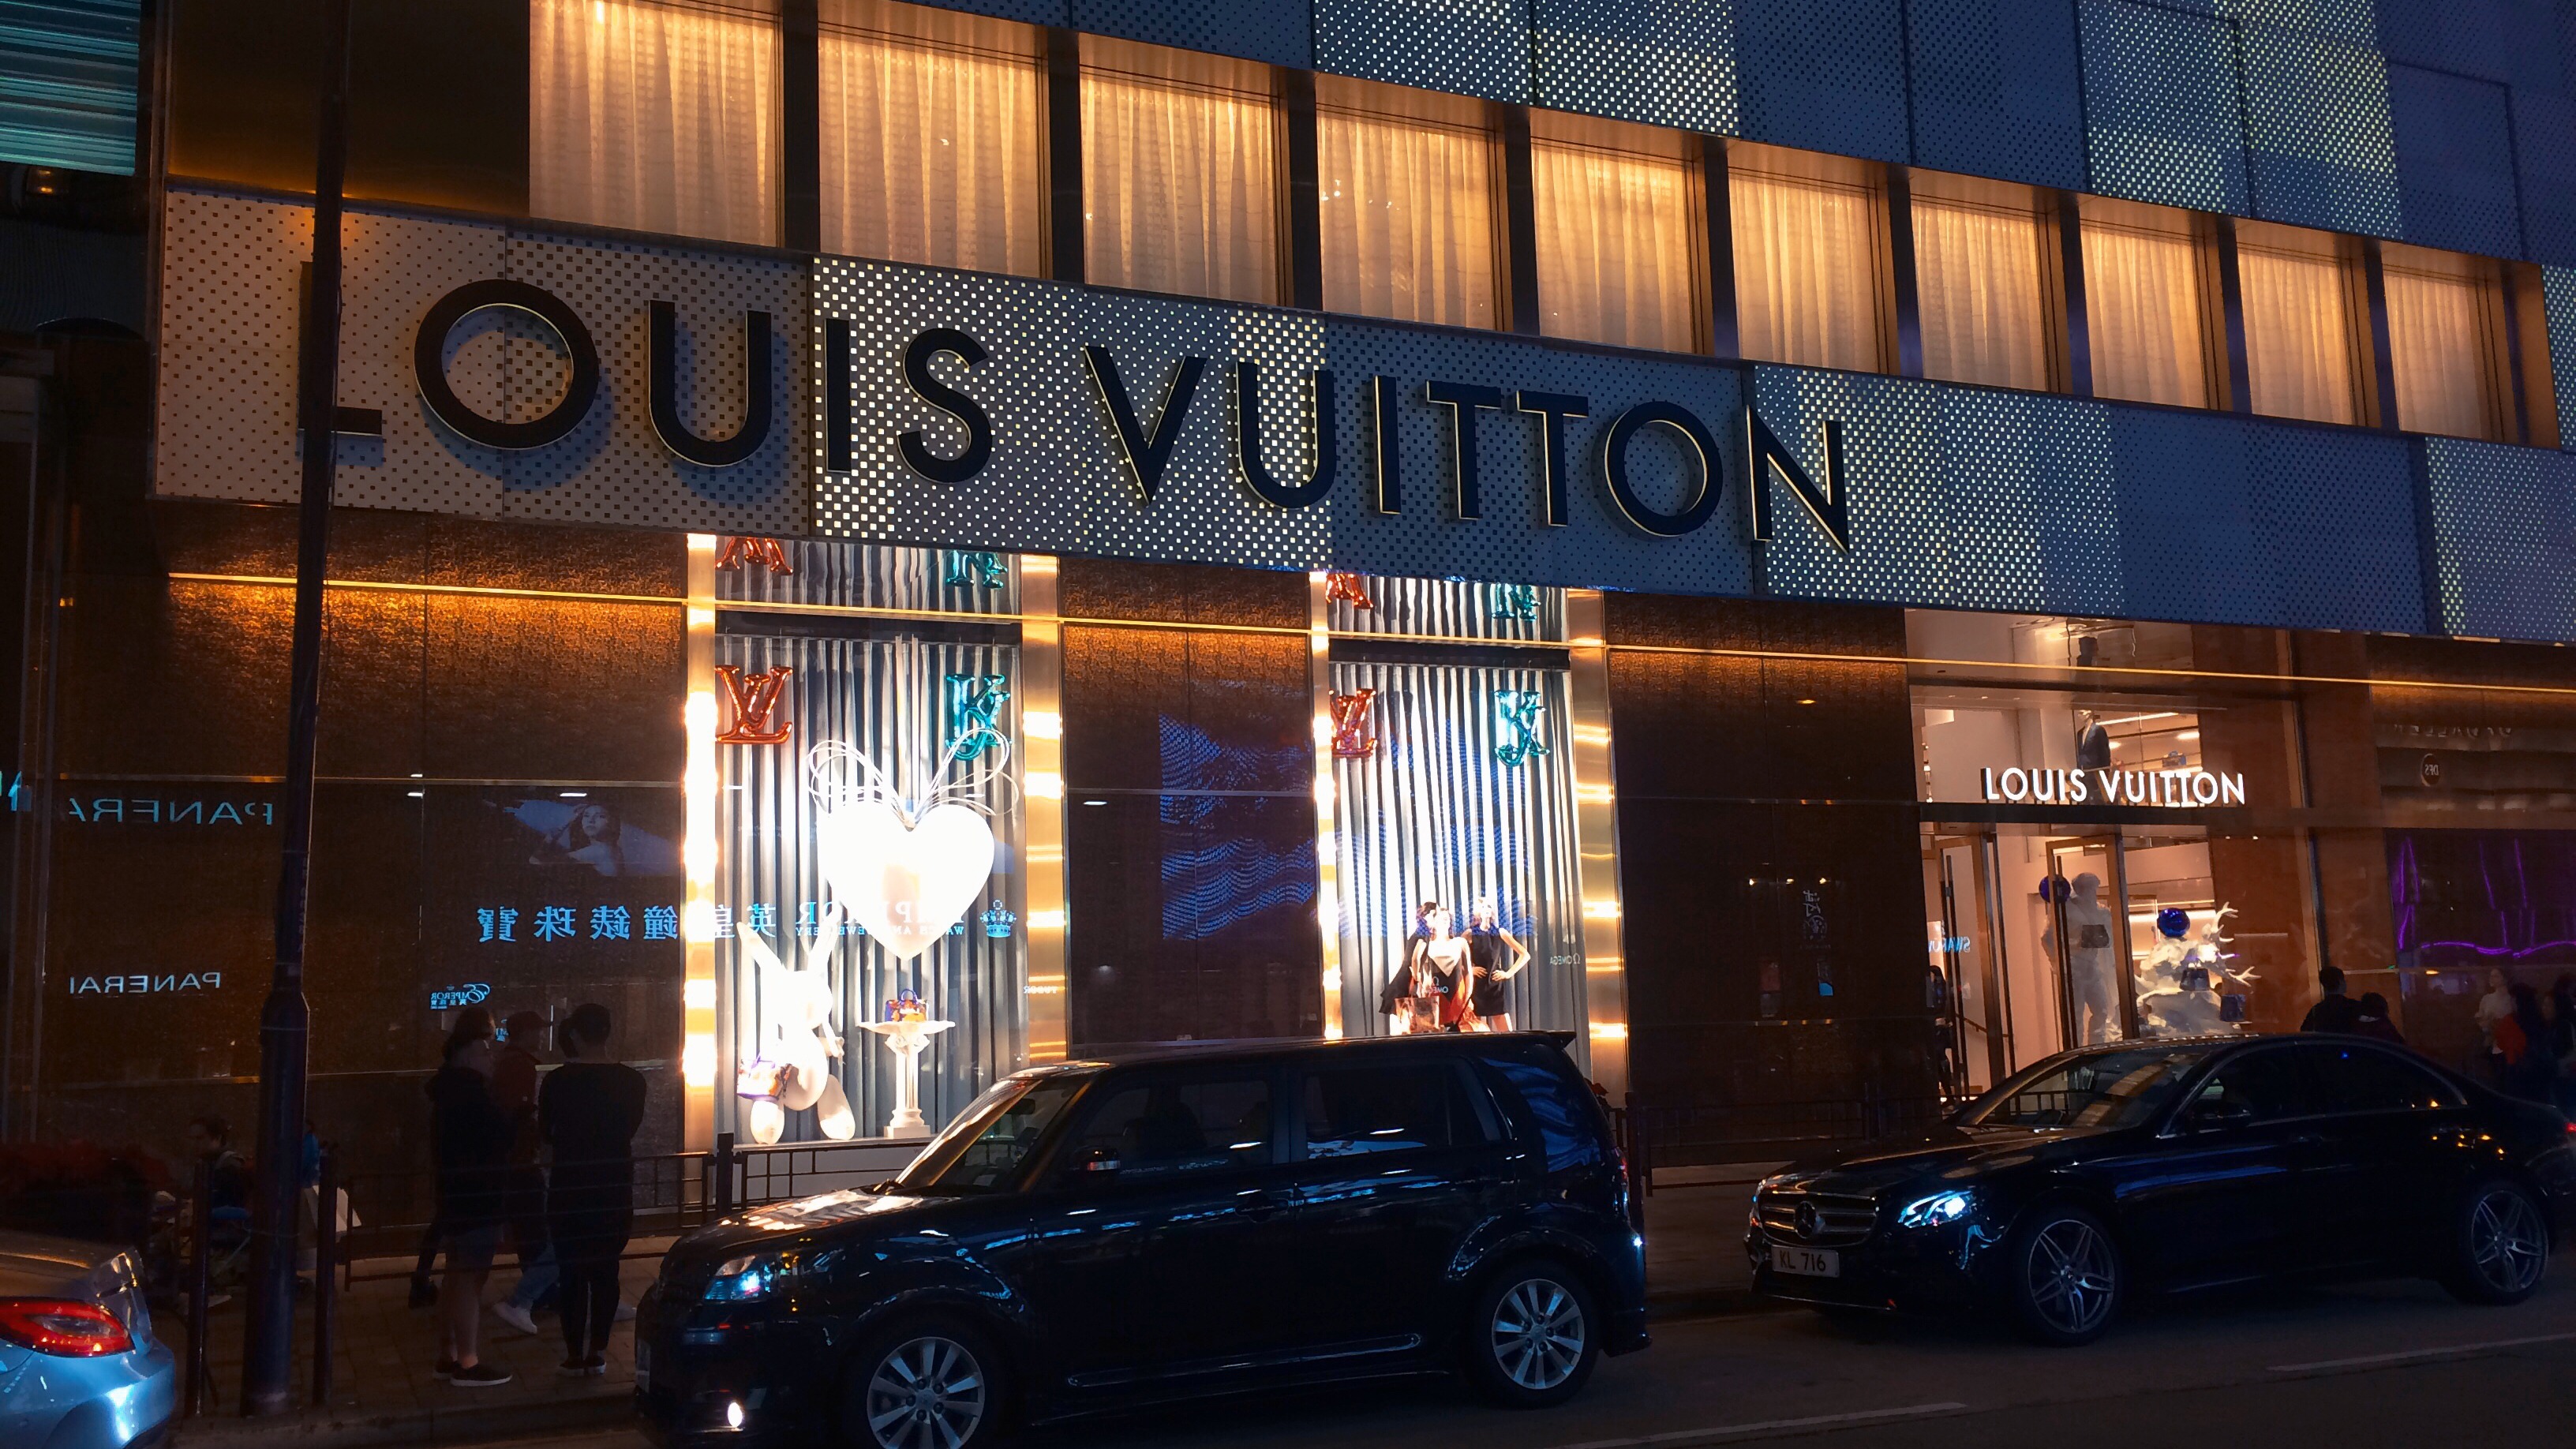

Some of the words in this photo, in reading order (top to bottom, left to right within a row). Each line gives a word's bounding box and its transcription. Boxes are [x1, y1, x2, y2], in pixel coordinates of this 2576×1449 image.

[1084, 345, 1849, 554] VUITTON
[1981, 767, 2088, 802] LOUIS
[2099, 769, 2246, 805] VUITTON
[1800, 1252, 1826, 1272] 716
